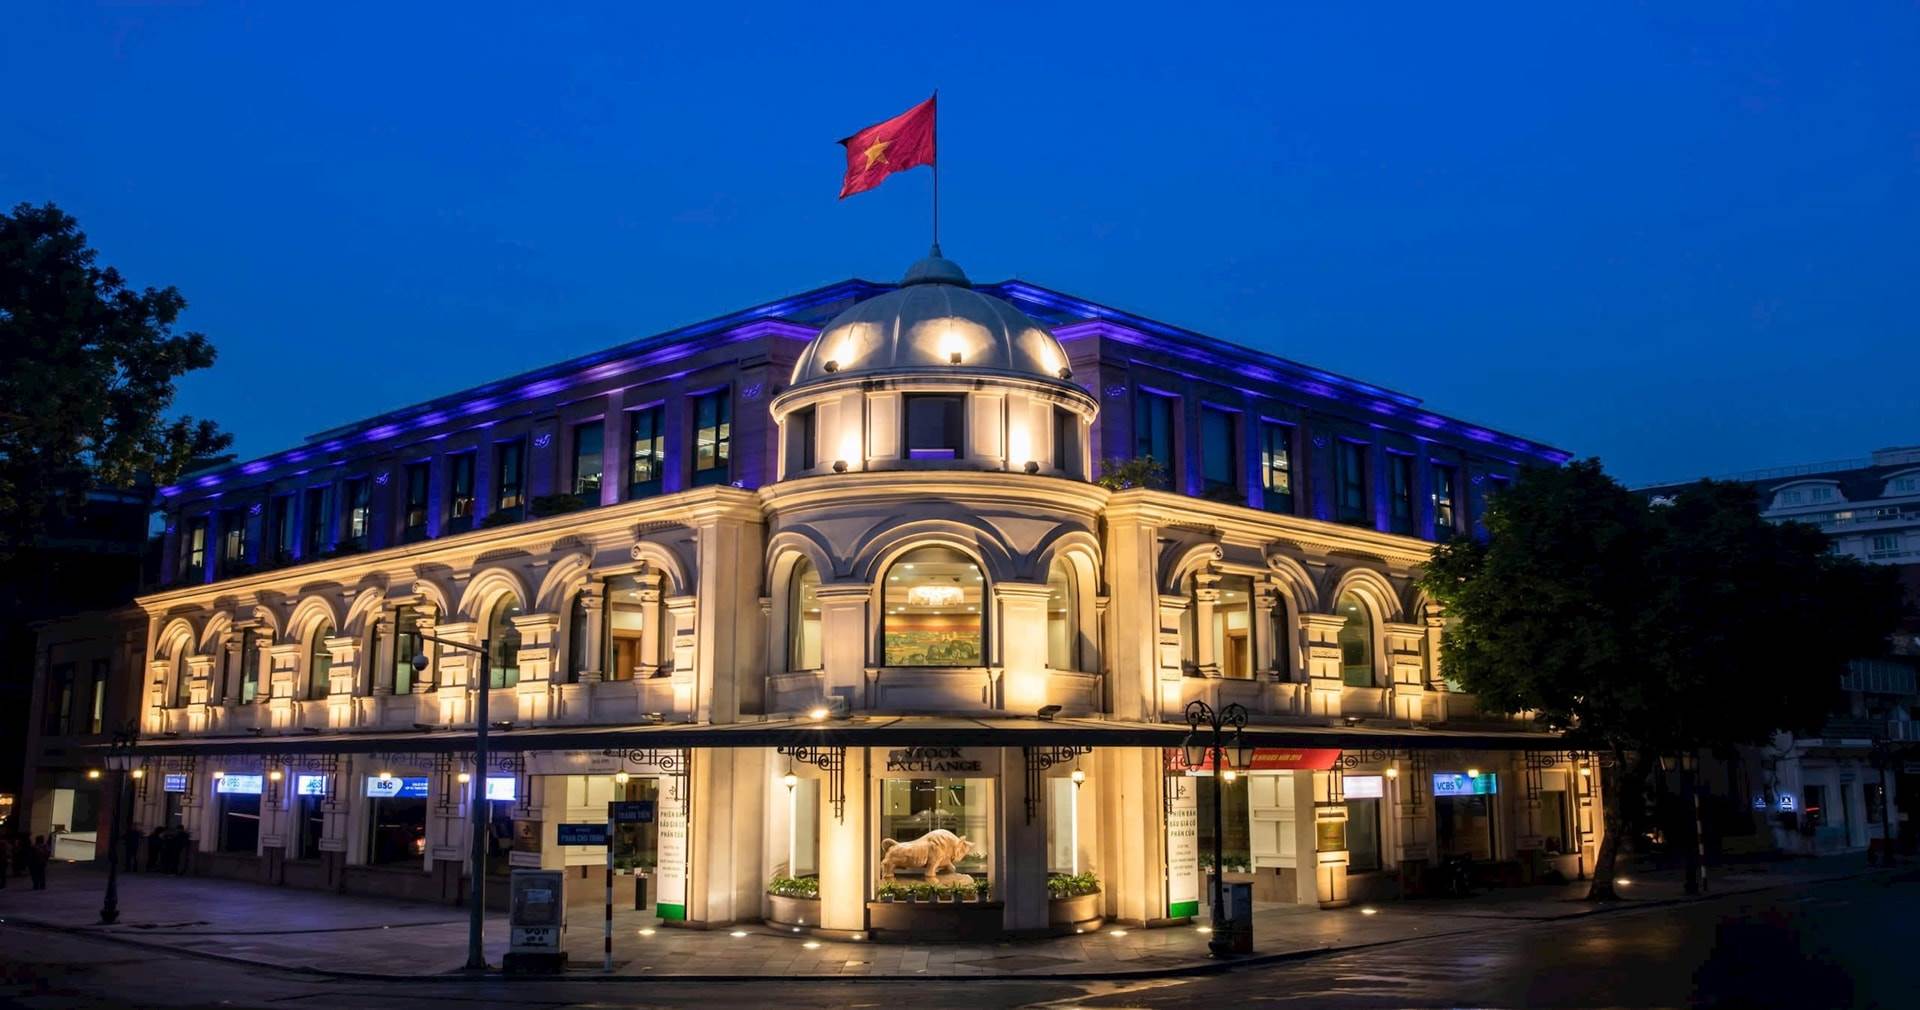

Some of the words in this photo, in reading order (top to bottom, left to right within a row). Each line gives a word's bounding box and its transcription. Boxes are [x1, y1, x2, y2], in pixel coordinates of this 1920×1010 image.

[886, 760, 982, 772] EXCHANGE
[377, 781, 393, 790] BSC
[1436, 781, 1455, 791] VCBS
